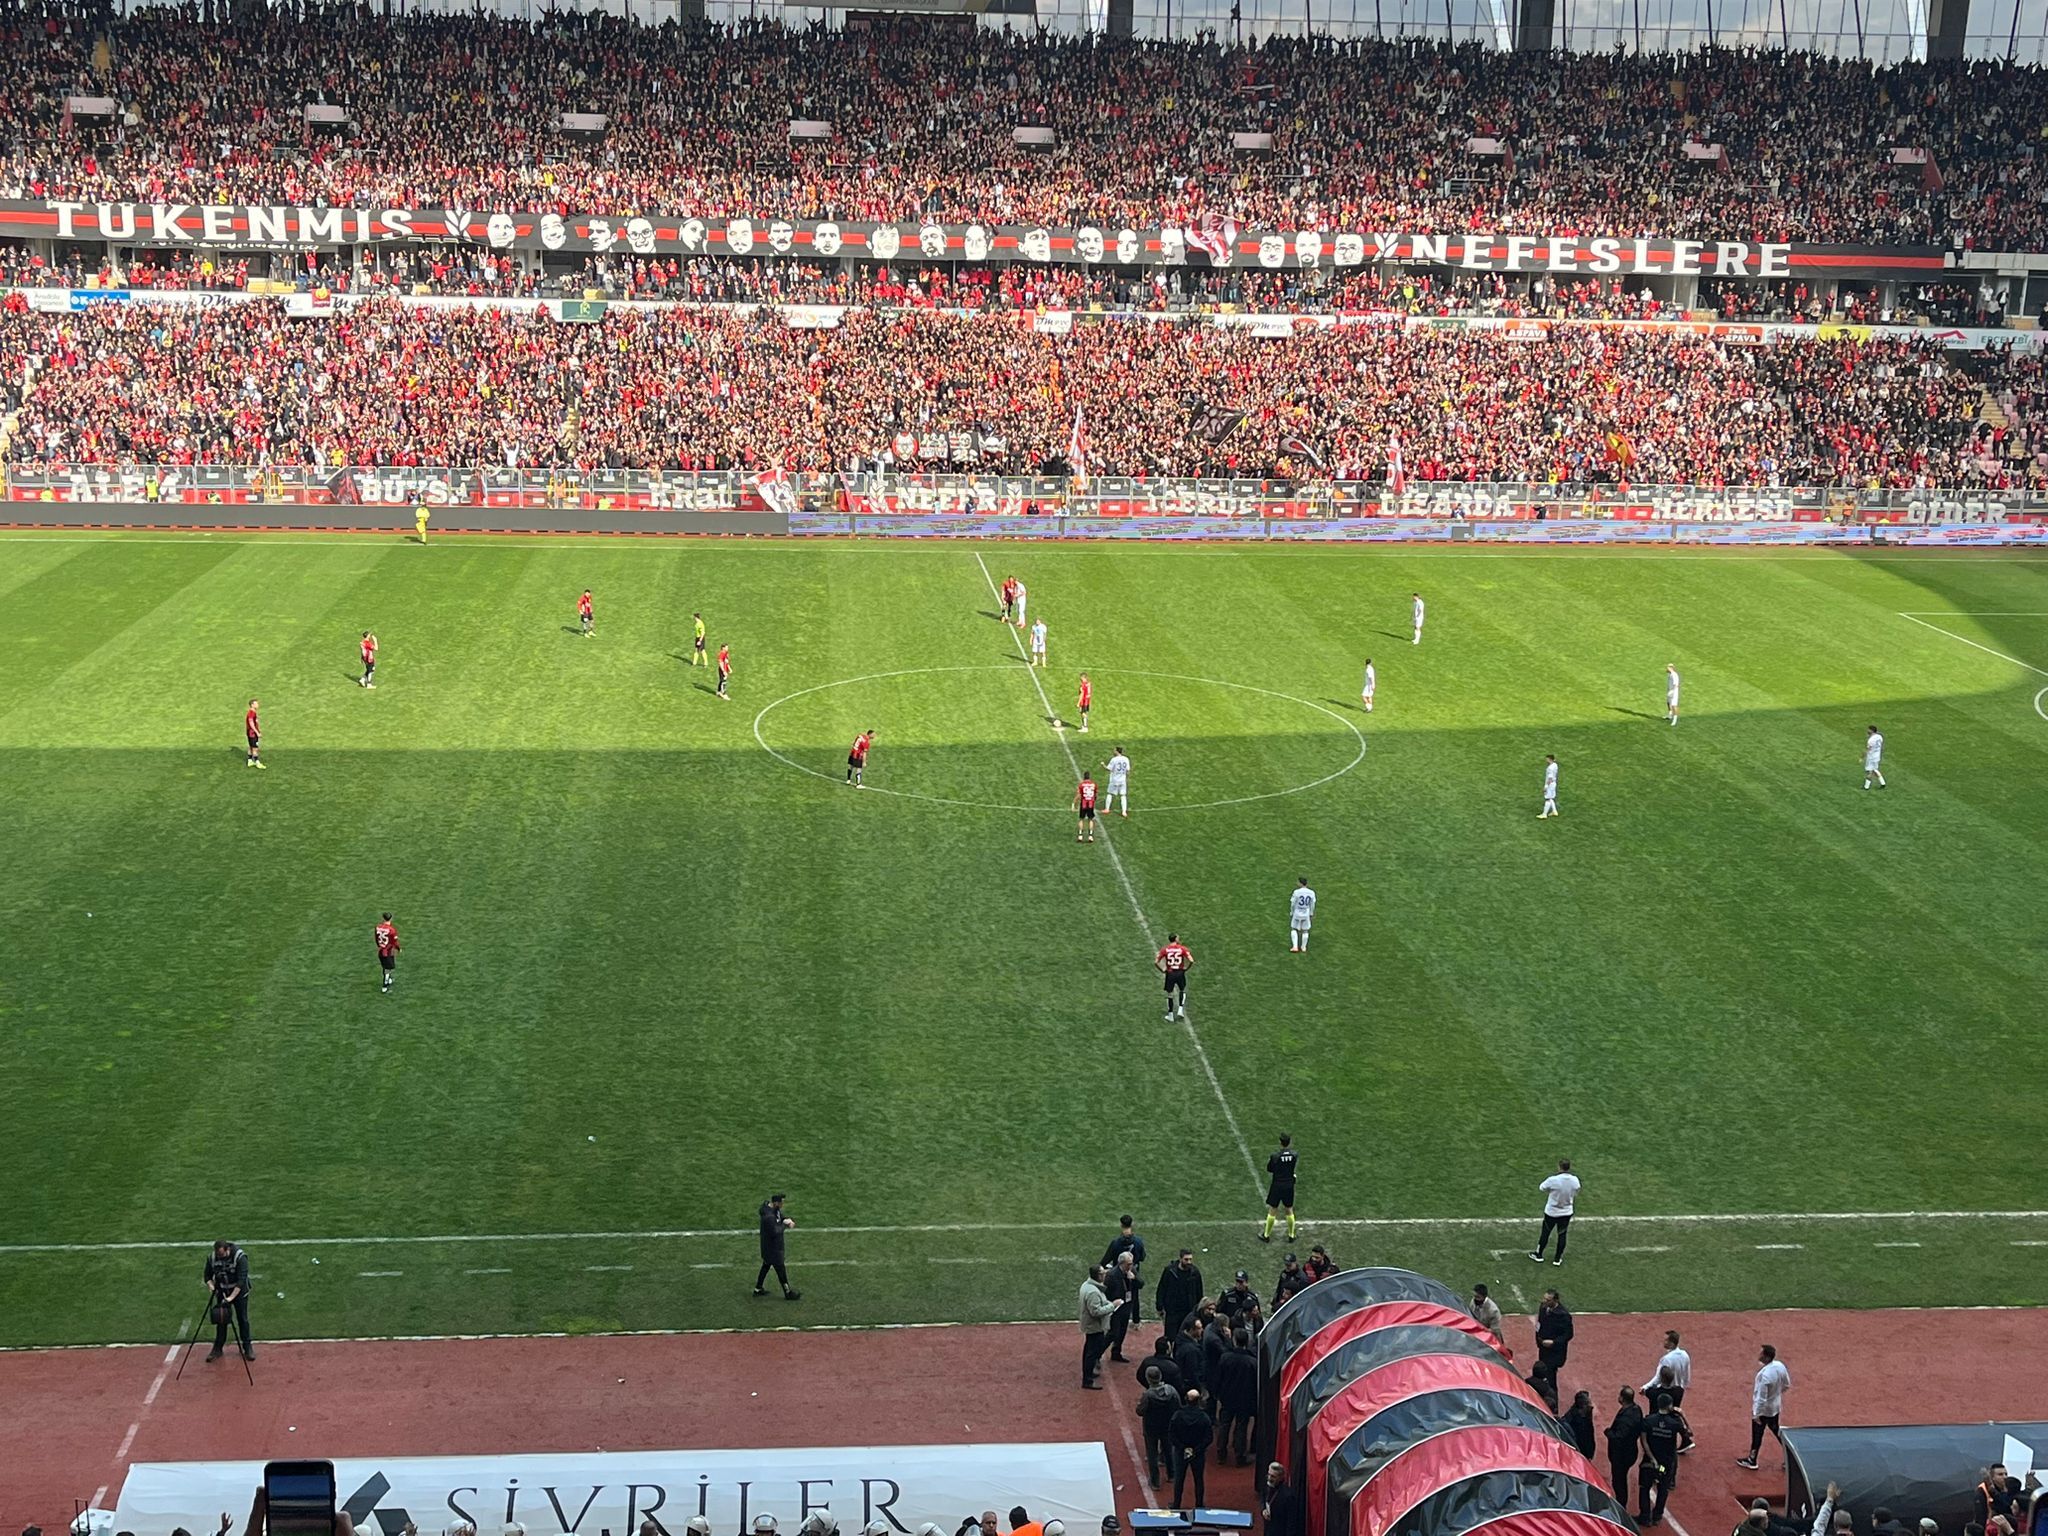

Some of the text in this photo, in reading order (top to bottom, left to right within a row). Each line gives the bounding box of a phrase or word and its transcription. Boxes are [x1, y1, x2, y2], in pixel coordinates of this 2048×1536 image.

[1410, 234, 1791, 277] NEFESLERE
[1298, 895, 1312, 907] 30
[1167, 952, 1183, 966] 55
[447, 1474, 916, 1535] SİVRİLER
